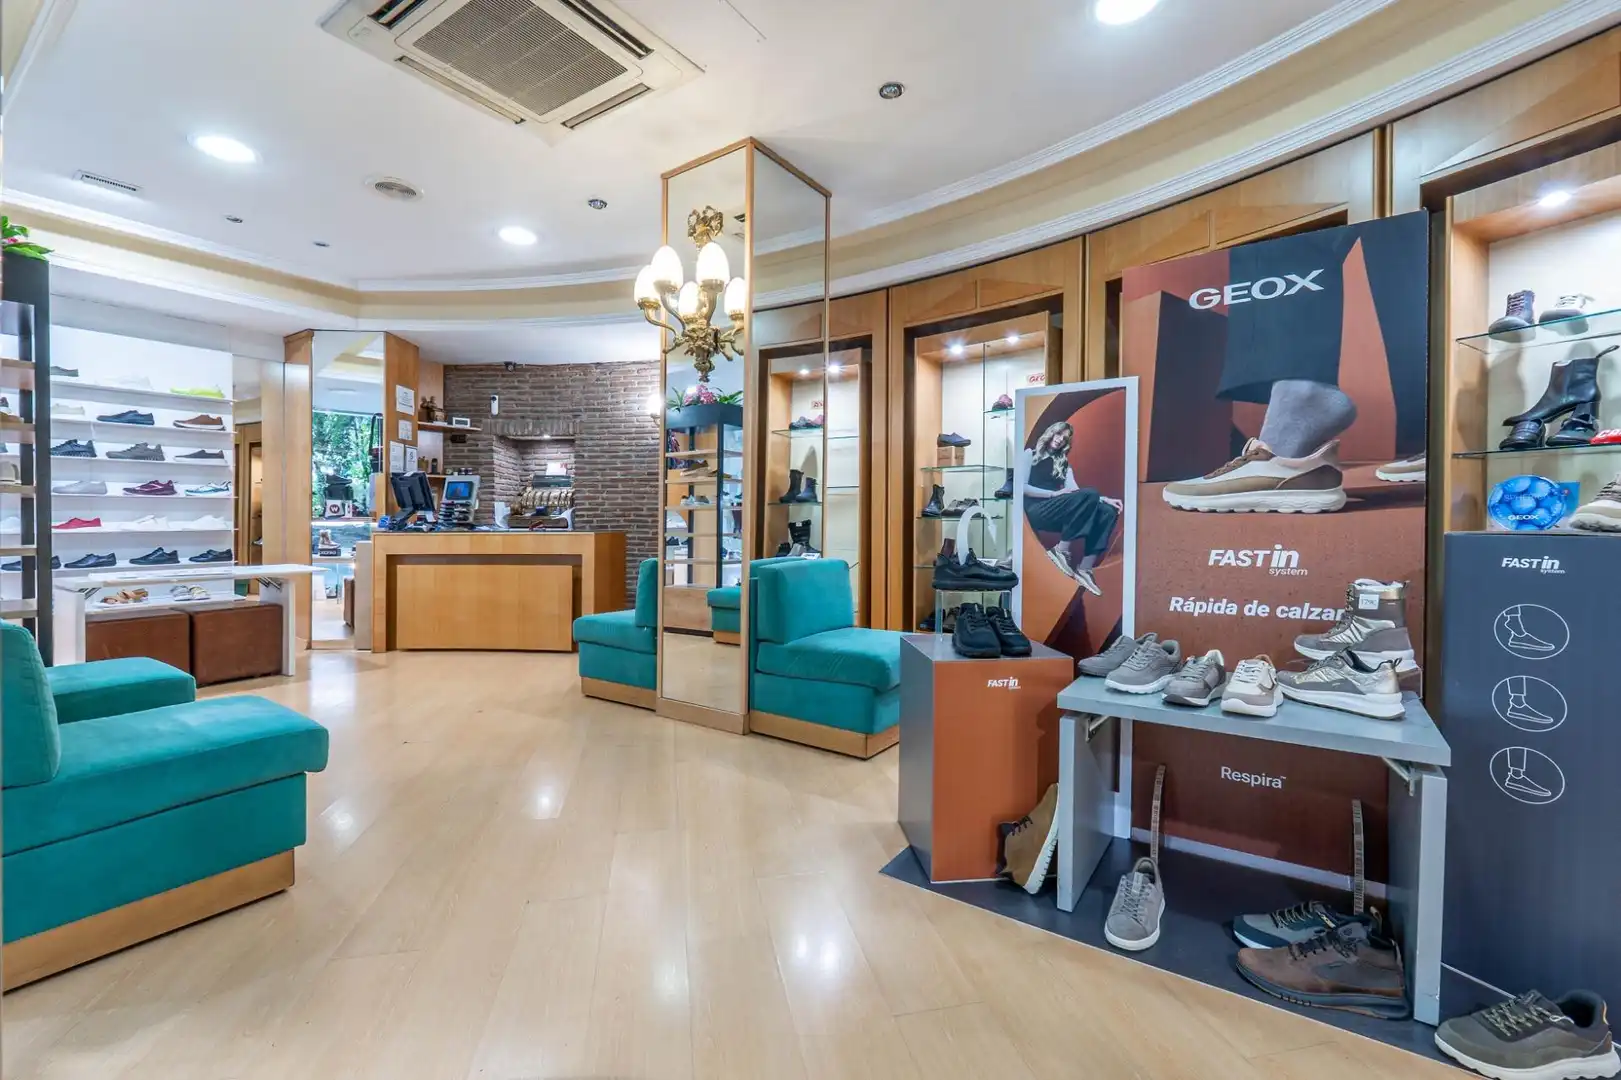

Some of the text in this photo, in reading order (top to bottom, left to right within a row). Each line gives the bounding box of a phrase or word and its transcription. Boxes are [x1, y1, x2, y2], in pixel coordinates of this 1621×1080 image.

[1188, 268, 1325, 310] GEOX
[1268, 567, 1308, 577] system
[1169, 596, 1345, 621] Rápida de calzar
